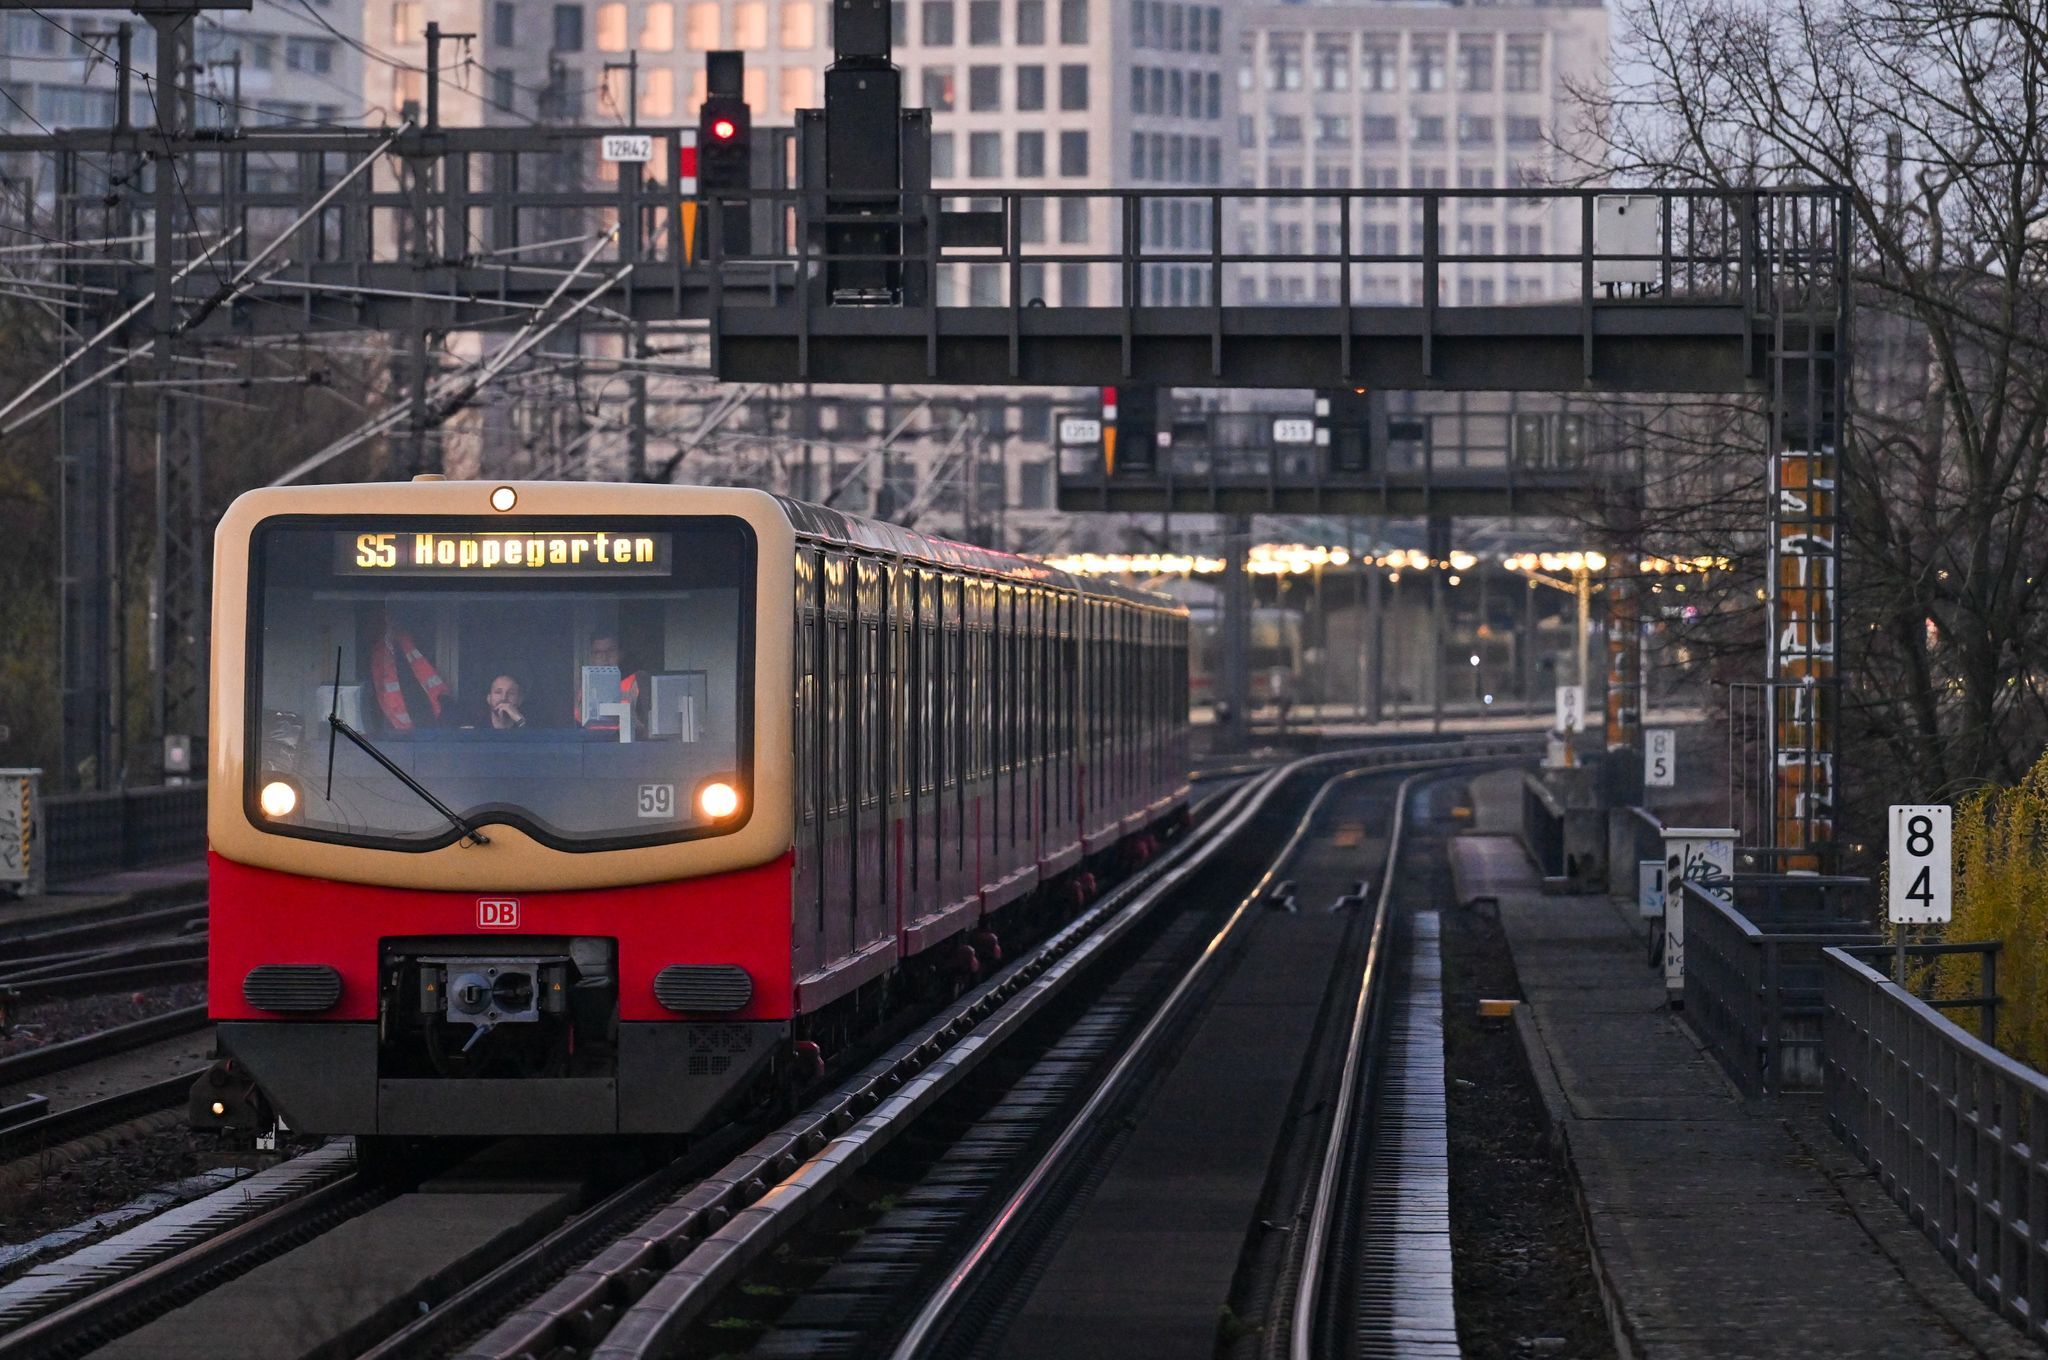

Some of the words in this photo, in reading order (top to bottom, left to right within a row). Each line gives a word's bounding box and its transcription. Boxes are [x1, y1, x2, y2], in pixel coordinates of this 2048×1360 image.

[608, 140, 649, 157] 12R42
[356, 533, 396, 568] S5
[415, 532, 654, 568] Hoppegarten
[1653, 735, 1665, 754] 8
[1654, 757, 1666, 778] 5
[640, 785, 670, 812] 59
[1906, 815, 1934, 857] 8
[1905, 866, 1934, 907] 4
[482, 903, 514, 923] DB
